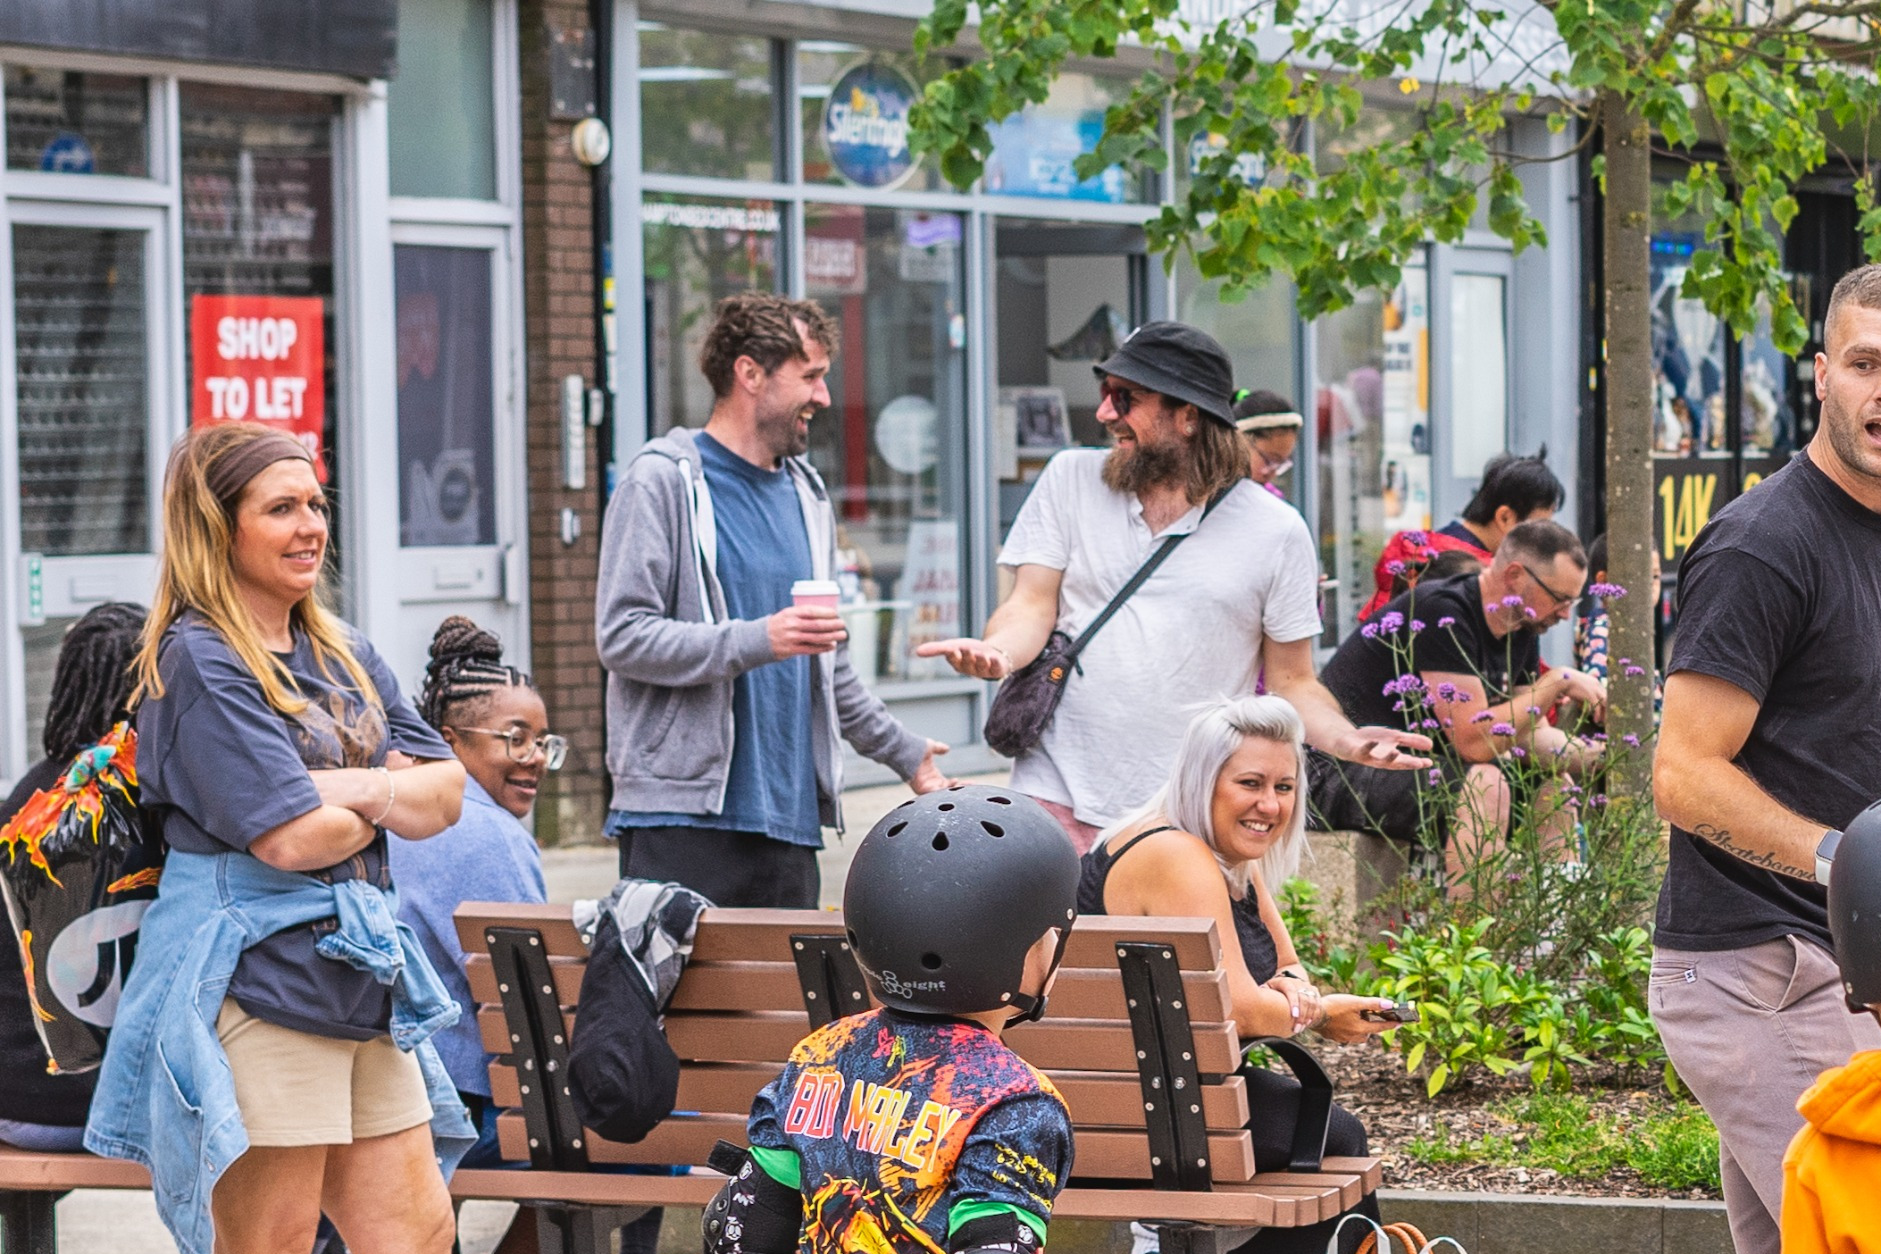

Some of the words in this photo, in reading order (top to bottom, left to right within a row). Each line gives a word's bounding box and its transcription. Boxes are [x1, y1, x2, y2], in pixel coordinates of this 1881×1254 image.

[217, 316, 298, 361] SHOP
[205, 376, 249, 420] TO
[254, 376, 308, 420] LET
[842, 1078, 963, 1174] MARLEY
